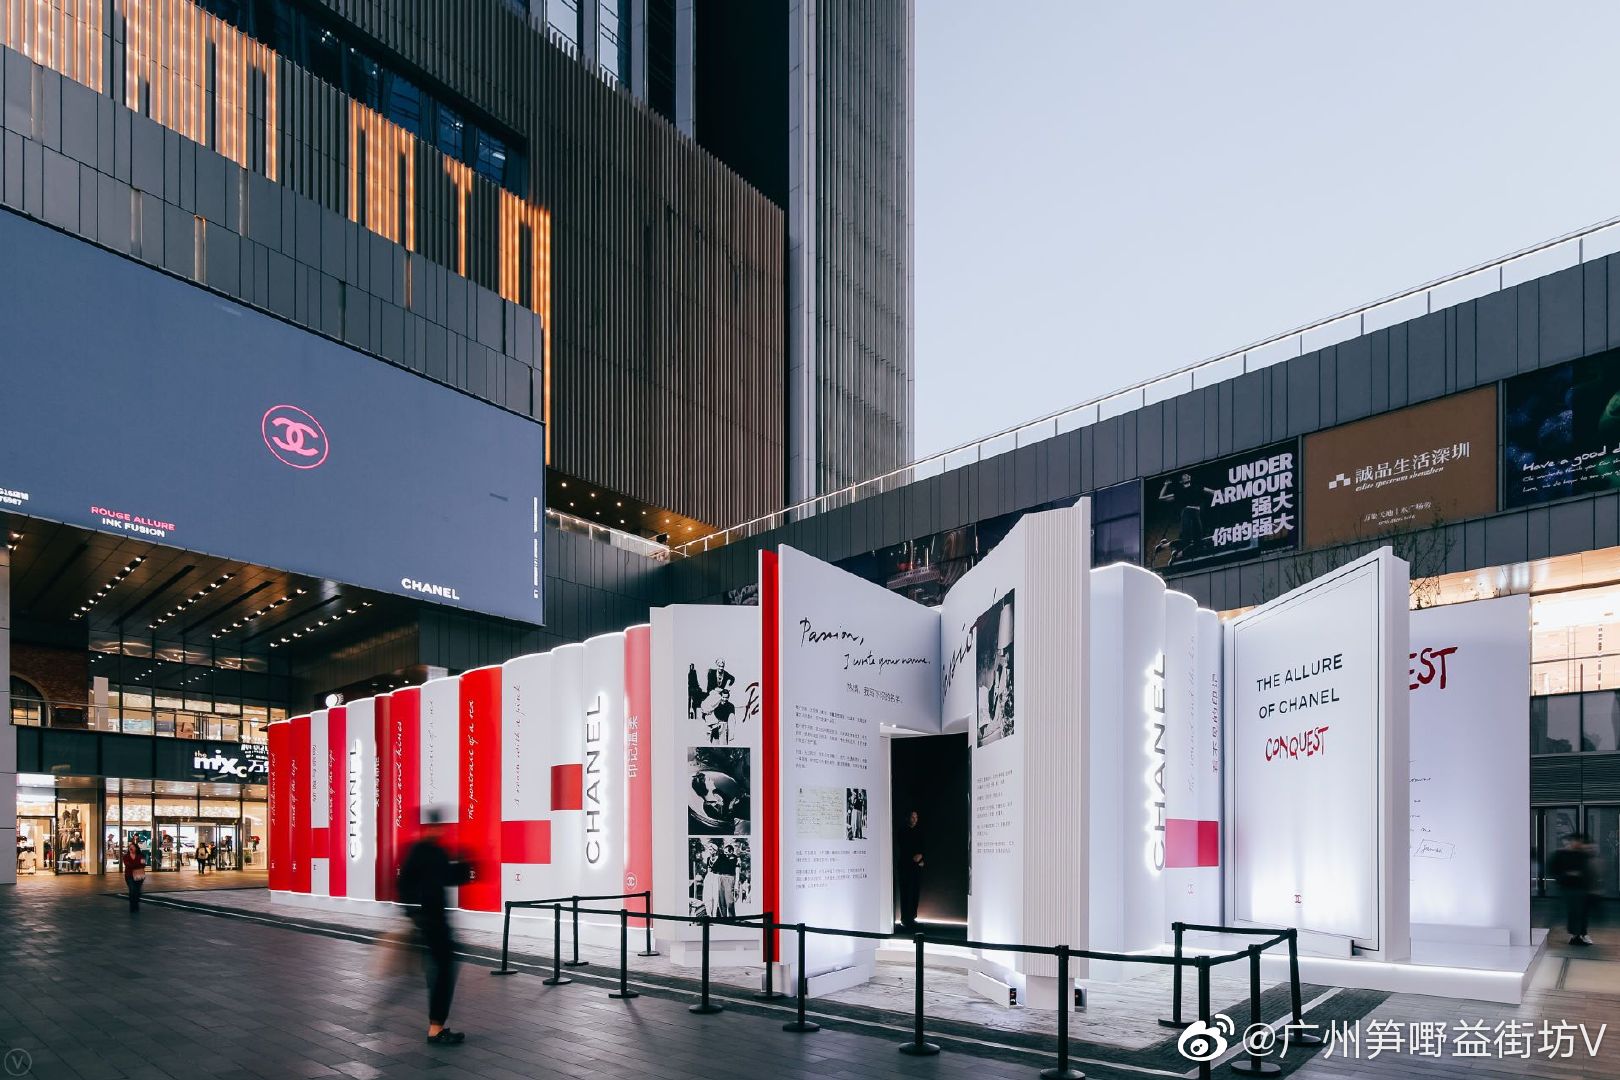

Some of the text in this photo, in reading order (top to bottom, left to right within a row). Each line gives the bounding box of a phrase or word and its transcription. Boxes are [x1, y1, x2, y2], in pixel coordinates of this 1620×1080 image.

[1228, 453, 1293, 484] UNDER
[1355, 442, 1470, 484] 誠品生活深圳
[1523, 461, 1555, 471] Have
[1571, 445, 1607, 467] good
[1211, 471, 1293, 507] ARMOUR
[1252, 491, 1293, 518] 强大
[91, 506, 176, 531] ROUGE ALLURE
[102, 517, 165, 538] INK FUSION
[1212, 513, 1294, 547] 你的强大
[401, 577, 460, 600] CHANEL
[1257, 653, 1344, 692] THE ALLURE
[1258, 688, 1340, 720] OF CHANEL
[1265, 726, 1329, 762] CONQUEST
[585, 695, 600, 864] CHANEL
[1153, 654, 1165, 872] CHANEL
[349, 740, 357, 858] CHANEL
